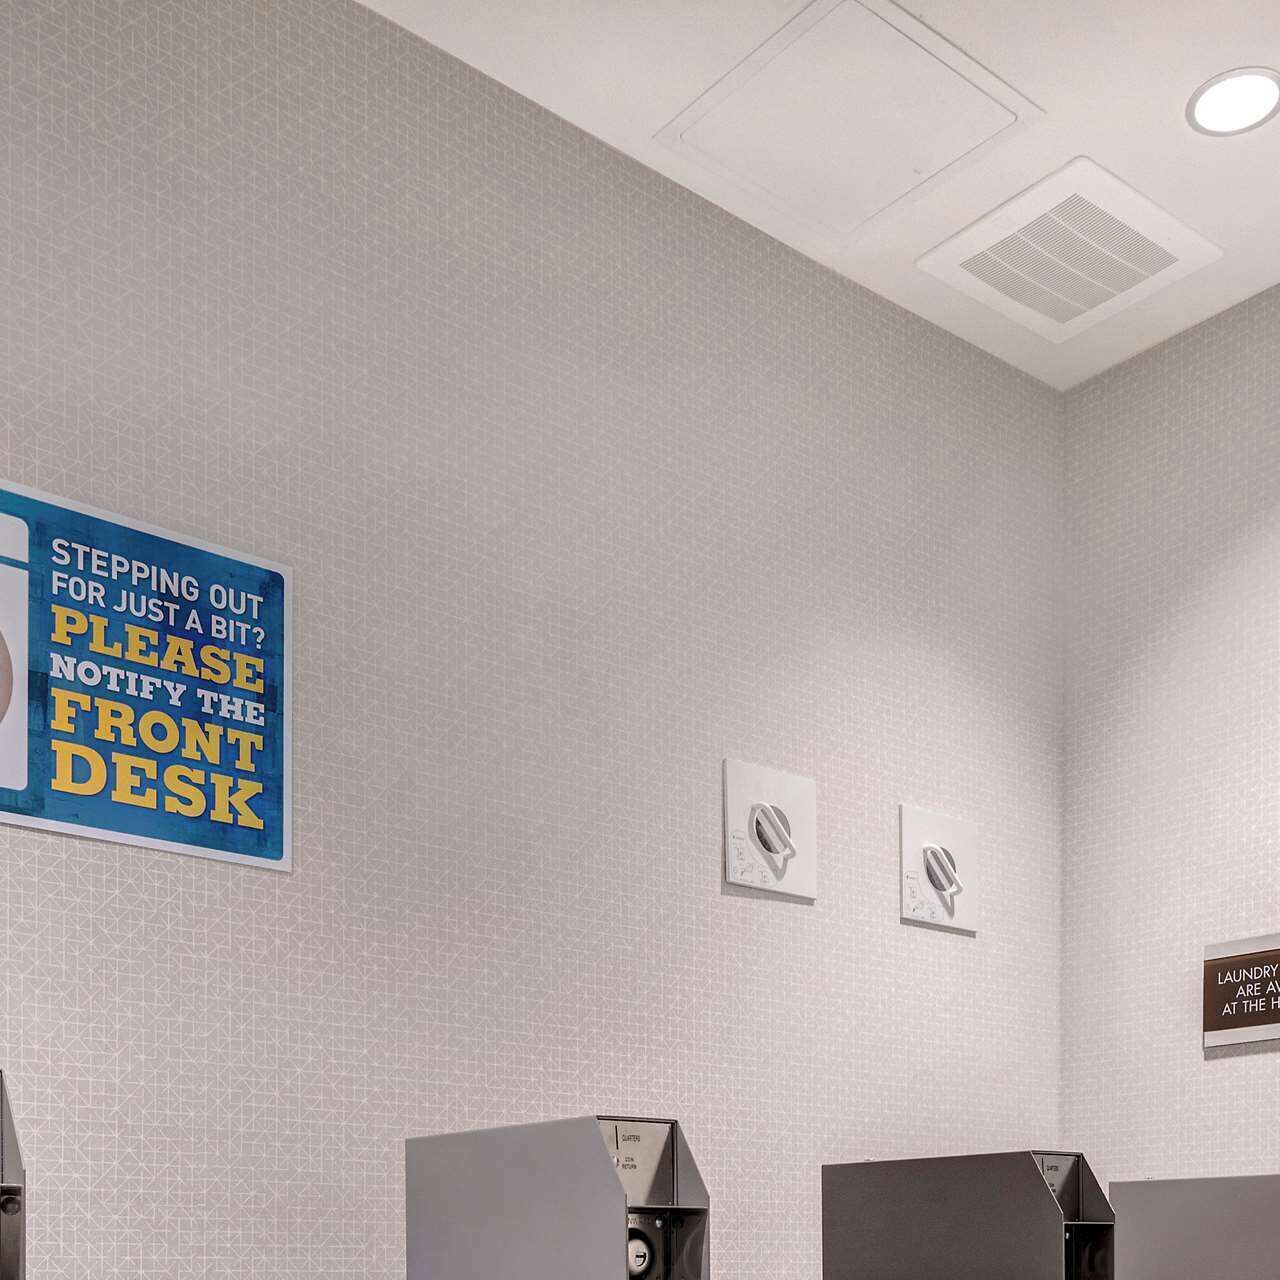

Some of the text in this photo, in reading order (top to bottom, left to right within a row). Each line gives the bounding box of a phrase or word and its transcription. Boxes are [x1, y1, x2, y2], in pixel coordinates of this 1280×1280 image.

[50, 537, 264, 620] STEPPING OUT
[50, 570, 266, 651] FOR JUST A BIT?
[50, 604, 264, 694] PLEASE
[50, 653, 265, 727] NOTIFY THE
[50, 687, 264, 773] FRONT
[50, 739, 264, 830] DESK
[1218, 963, 1279, 985] LAUNDRY
[1222, 1001, 1238, 1016] AT
[1242, 998, 1266, 1014] THE
[1235, 983, 1261, 999] ARE
